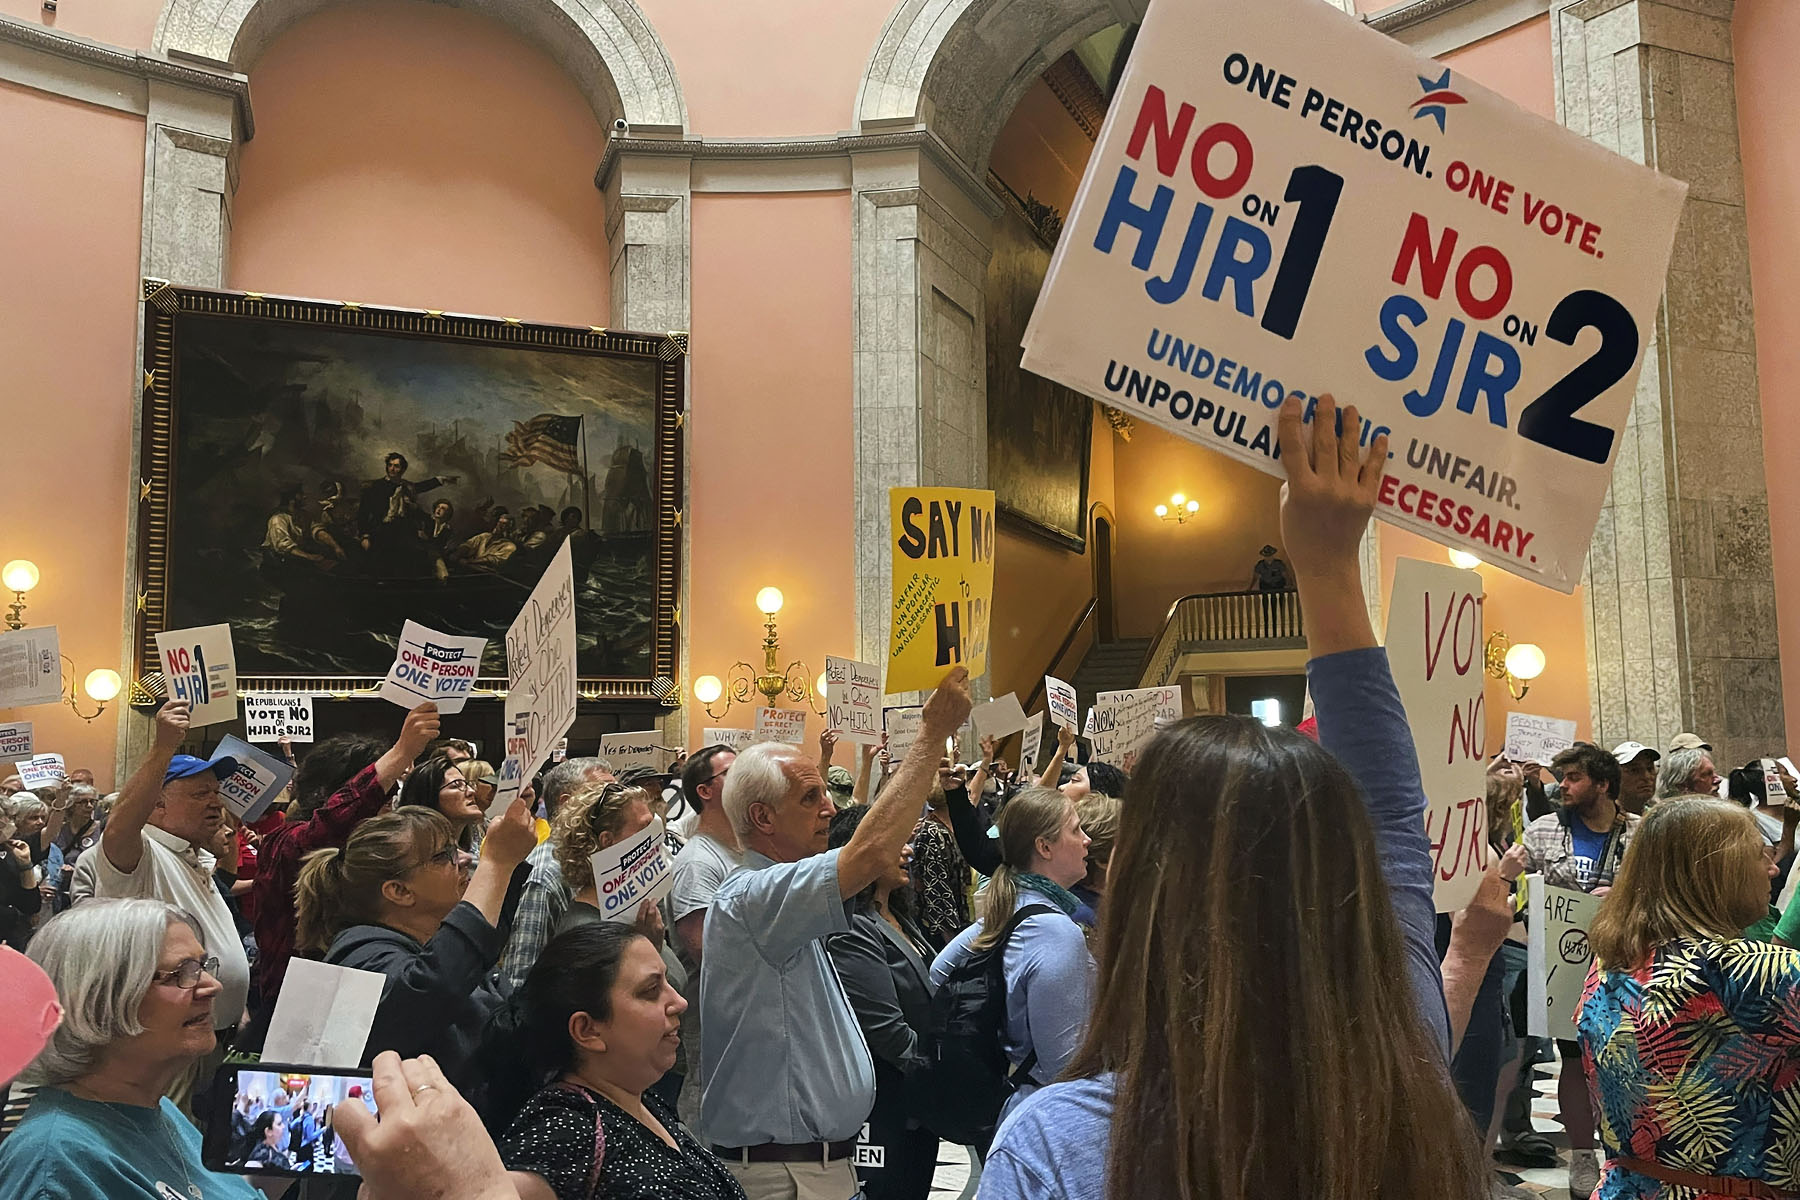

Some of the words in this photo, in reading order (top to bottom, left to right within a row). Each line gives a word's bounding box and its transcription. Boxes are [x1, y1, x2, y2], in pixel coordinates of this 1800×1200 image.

[1125, 84, 1254, 199] NO
[1242, 194, 1280, 227] ON
[1224, 53, 1297, 109] ONE
[1300, 87, 1432, 179] PERSON.
[1445, 160, 1515, 215] ONE
[1523, 192, 1604, 259] VOTE.
[1391, 211, 1513, 320] NO
[1503, 314, 1538, 346] ON
[1406, 438, 1521, 511] UNFAIR.
[898, 496, 962, 559] SAY
[970, 506, 994, 564] NO
[1424, 591, 1484, 681] VO
[166, 647, 190, 675] NO
[402, 650, 429, 670] ONE
[431, 661, 475, 677] PERSON
[426, 646, 462, 659] PROTECT
[395, 663, 432, 689] ONE
[435, 678, 471, 692] VOTE
[248, 710, 285, 720] VOTE
[289, 706, 309, 721] NO
[275, 718, 285, 727] ON
[763, 709, 806, 721] PROTECT
[829, 704, 843, 729] NO
[1094, 708, 1116, 732] NOW
[286, 725, 312, 736] SJR2
[714, 731, 737, 742] WHY
[2, 743, 30, 753] VOTE
[603, 742, 617, 756] Yes
[24, 770, 47, 780] ONE
[223, 780, 254, 804] VOTE
[622, 839, 651, 867] PROTECT
[602, 870, 628, 894] ONE
[628, 842, 663, 878] PERSON
[605, 880, 638, 910] ONE
[635, 854, 666, 888] VOTE
